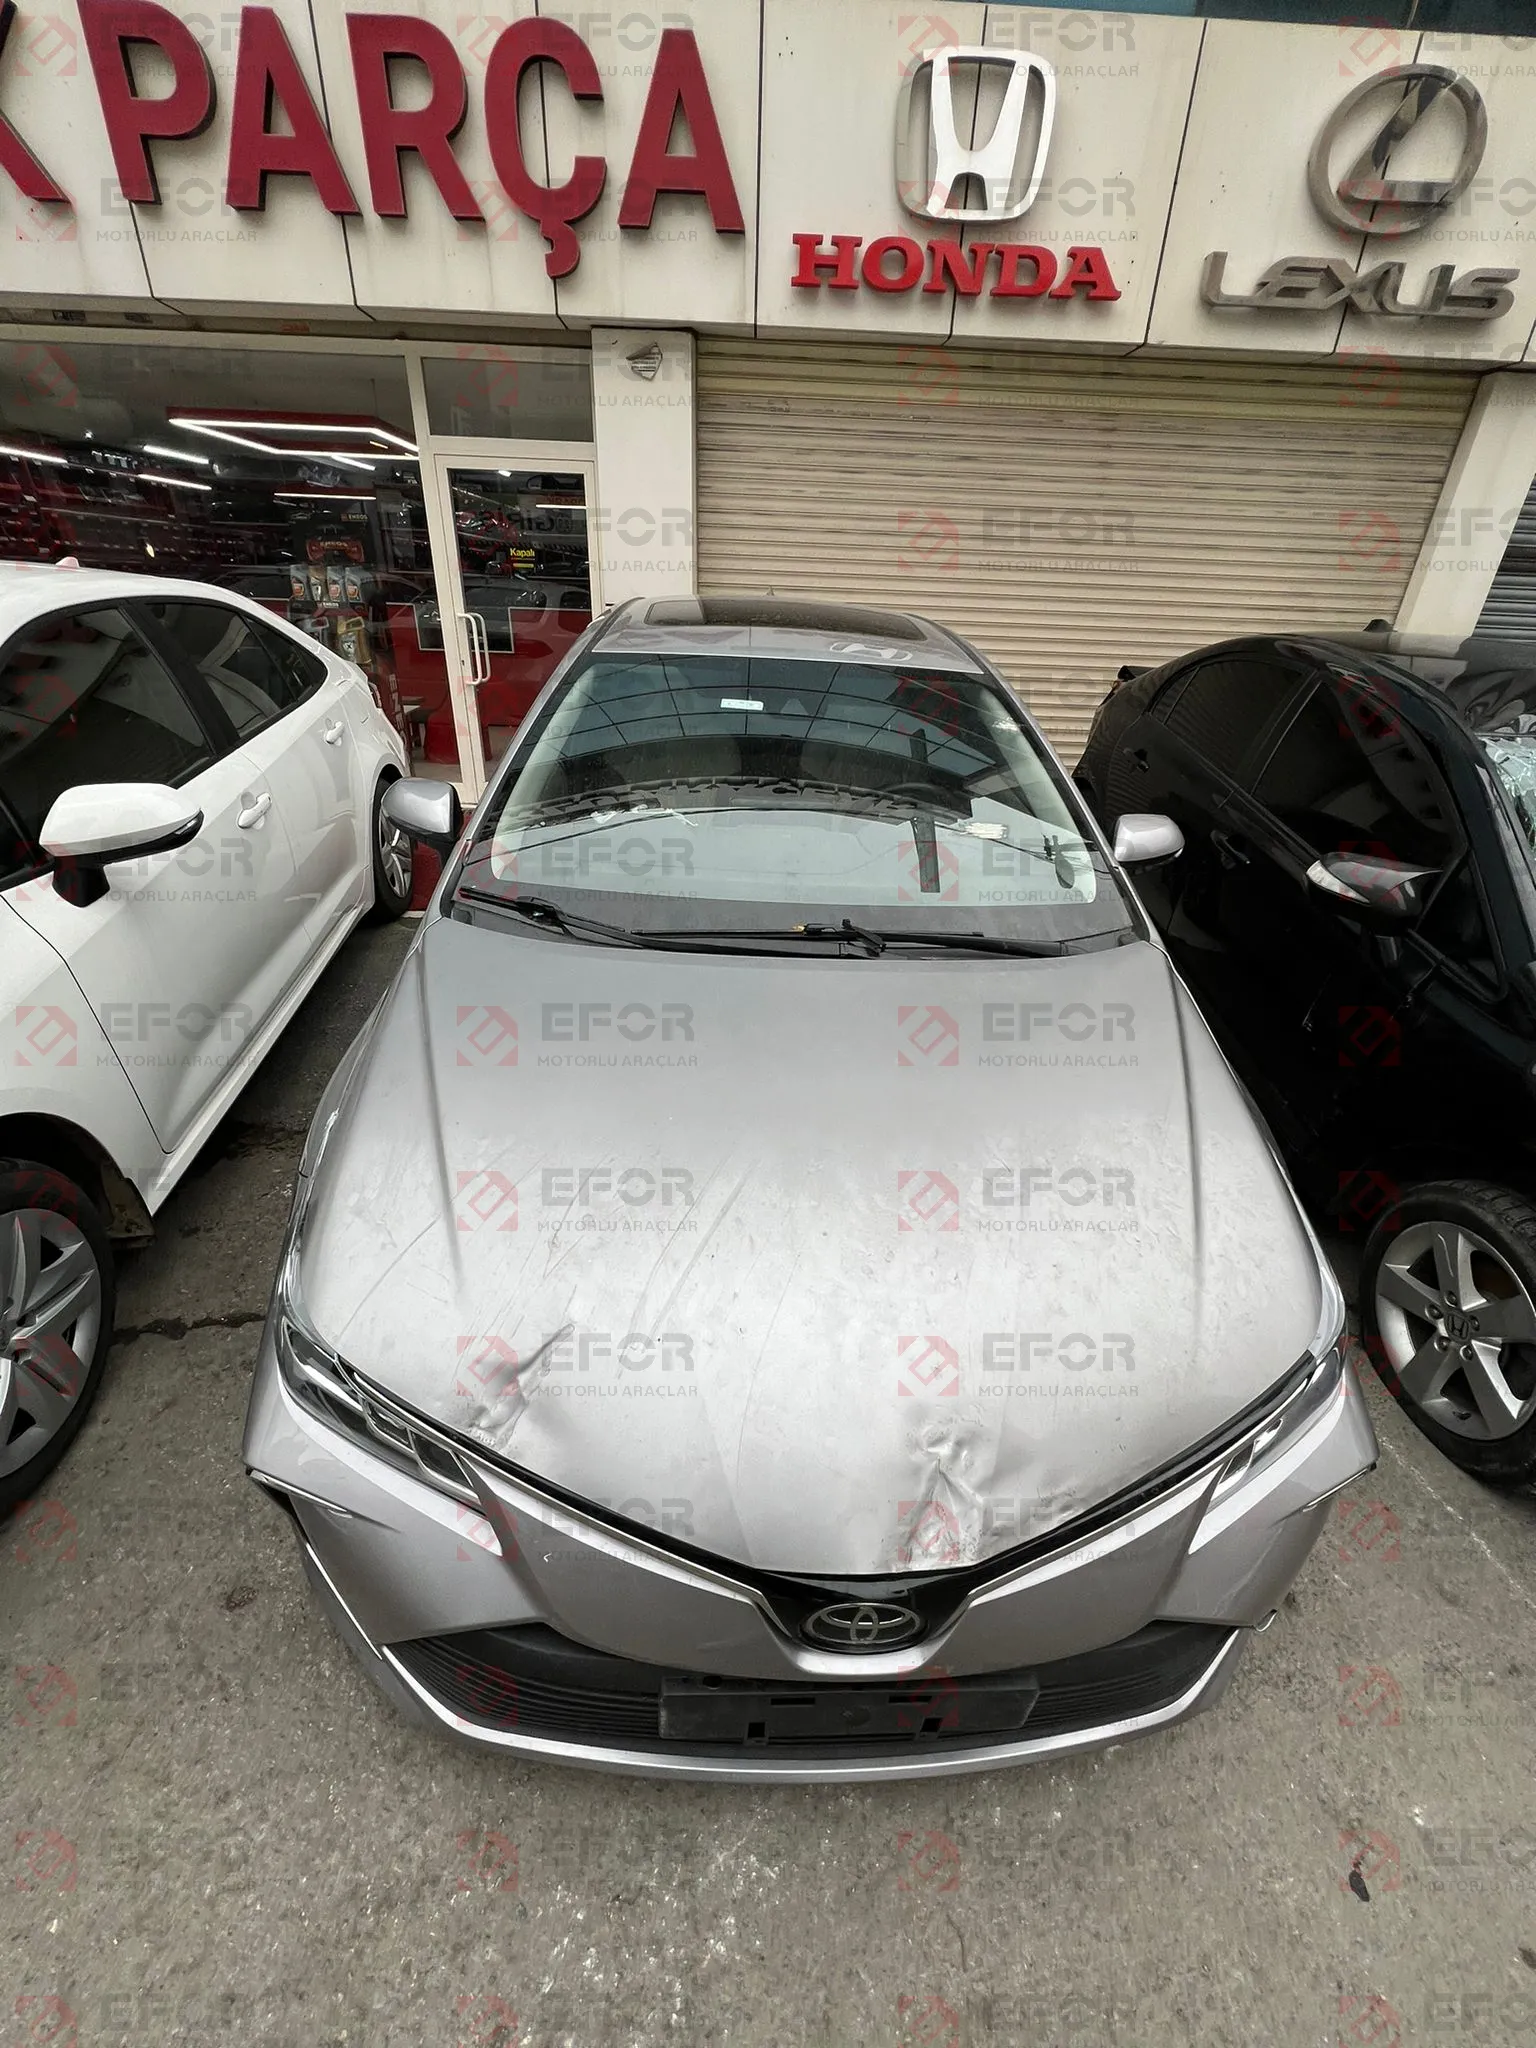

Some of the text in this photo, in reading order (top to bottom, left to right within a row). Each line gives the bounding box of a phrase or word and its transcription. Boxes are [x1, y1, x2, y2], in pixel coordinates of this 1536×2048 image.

[77, 0, 746, 278] PARÇA
[791, 233, 1122, 302] HONDA
[1202, 251, 1520, 320] LEXUS
